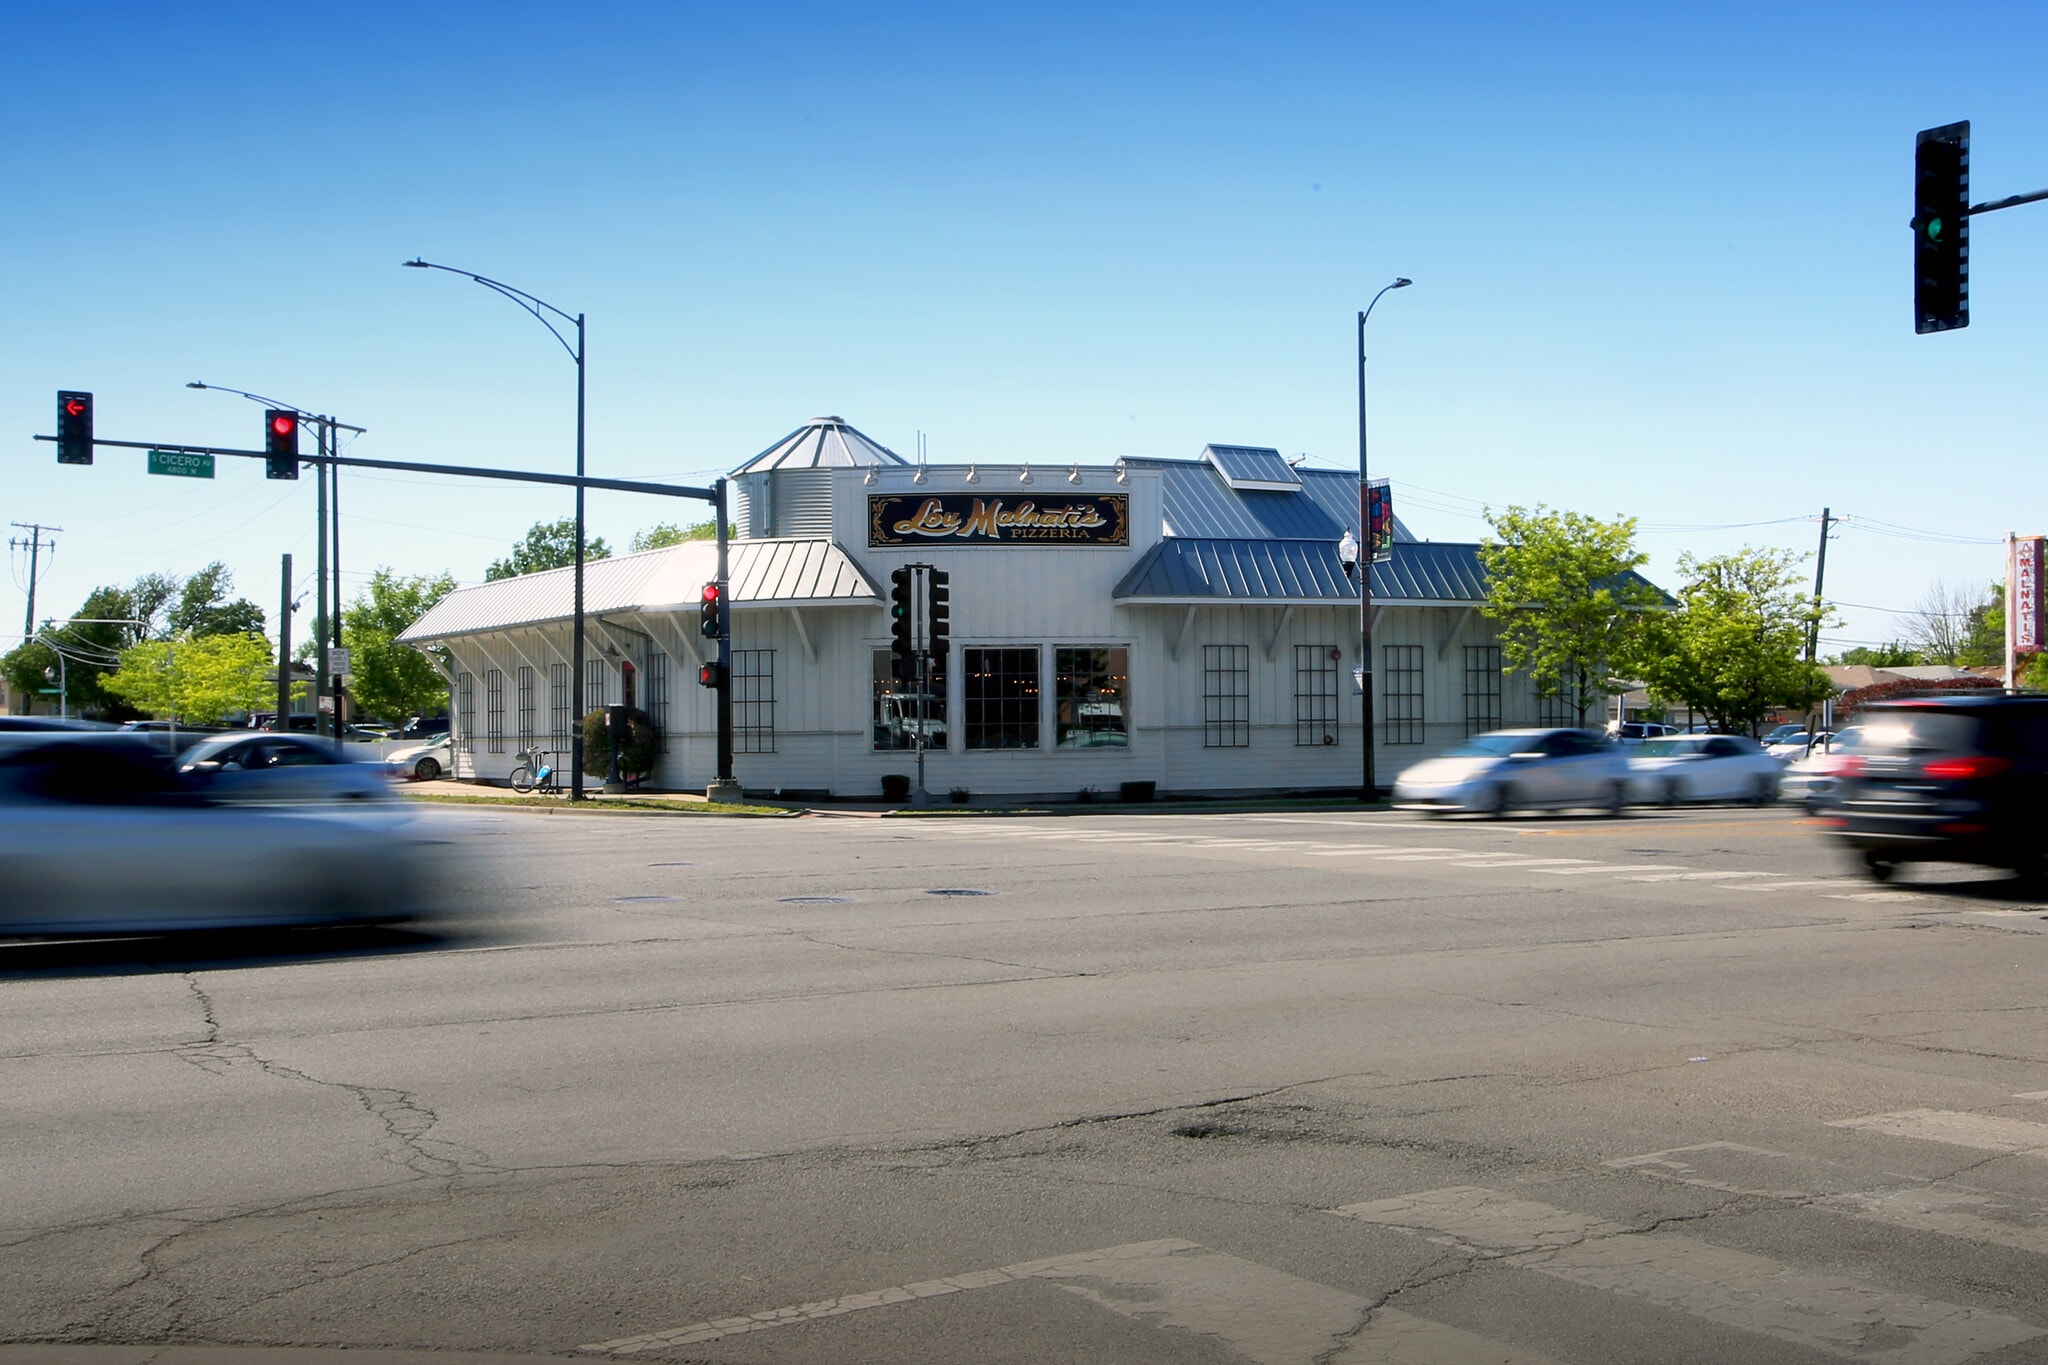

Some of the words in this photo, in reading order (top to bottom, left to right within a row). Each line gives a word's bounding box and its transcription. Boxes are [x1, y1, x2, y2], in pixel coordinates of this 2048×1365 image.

[159, 454, 200, 467] CICERO
[202, 459, 212, 467] AV
[166, 466, 187, 474] 4800
[893, 497, 961, 537] Lou
[956, 497, 1107, 539] Malnati's
[1010, 528, 1091, 539] PIZZERIA
